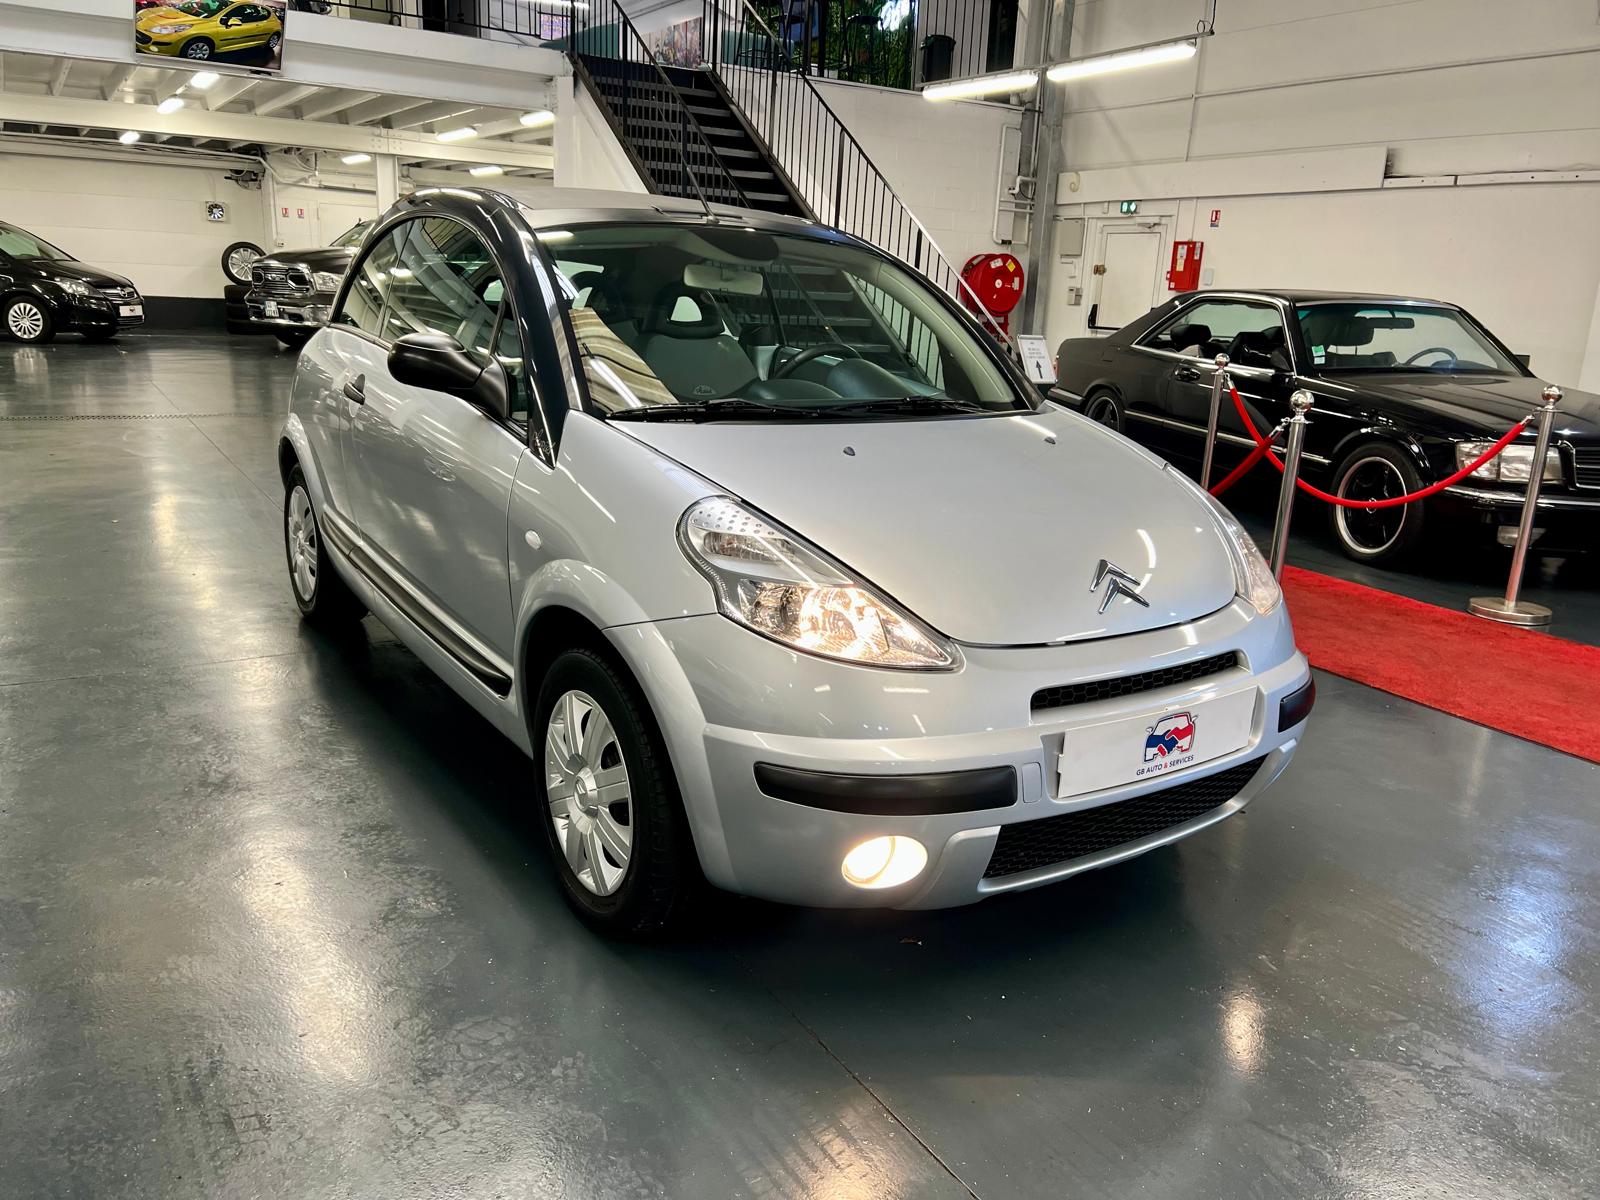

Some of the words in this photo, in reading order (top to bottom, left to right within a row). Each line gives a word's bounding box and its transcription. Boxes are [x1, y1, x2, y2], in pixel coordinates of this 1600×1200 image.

[1136, 768, 1146, 776] GB
[1146, 763, 1163, 774] AUTO
[1169, 755, 1194, 767] SERVICES
